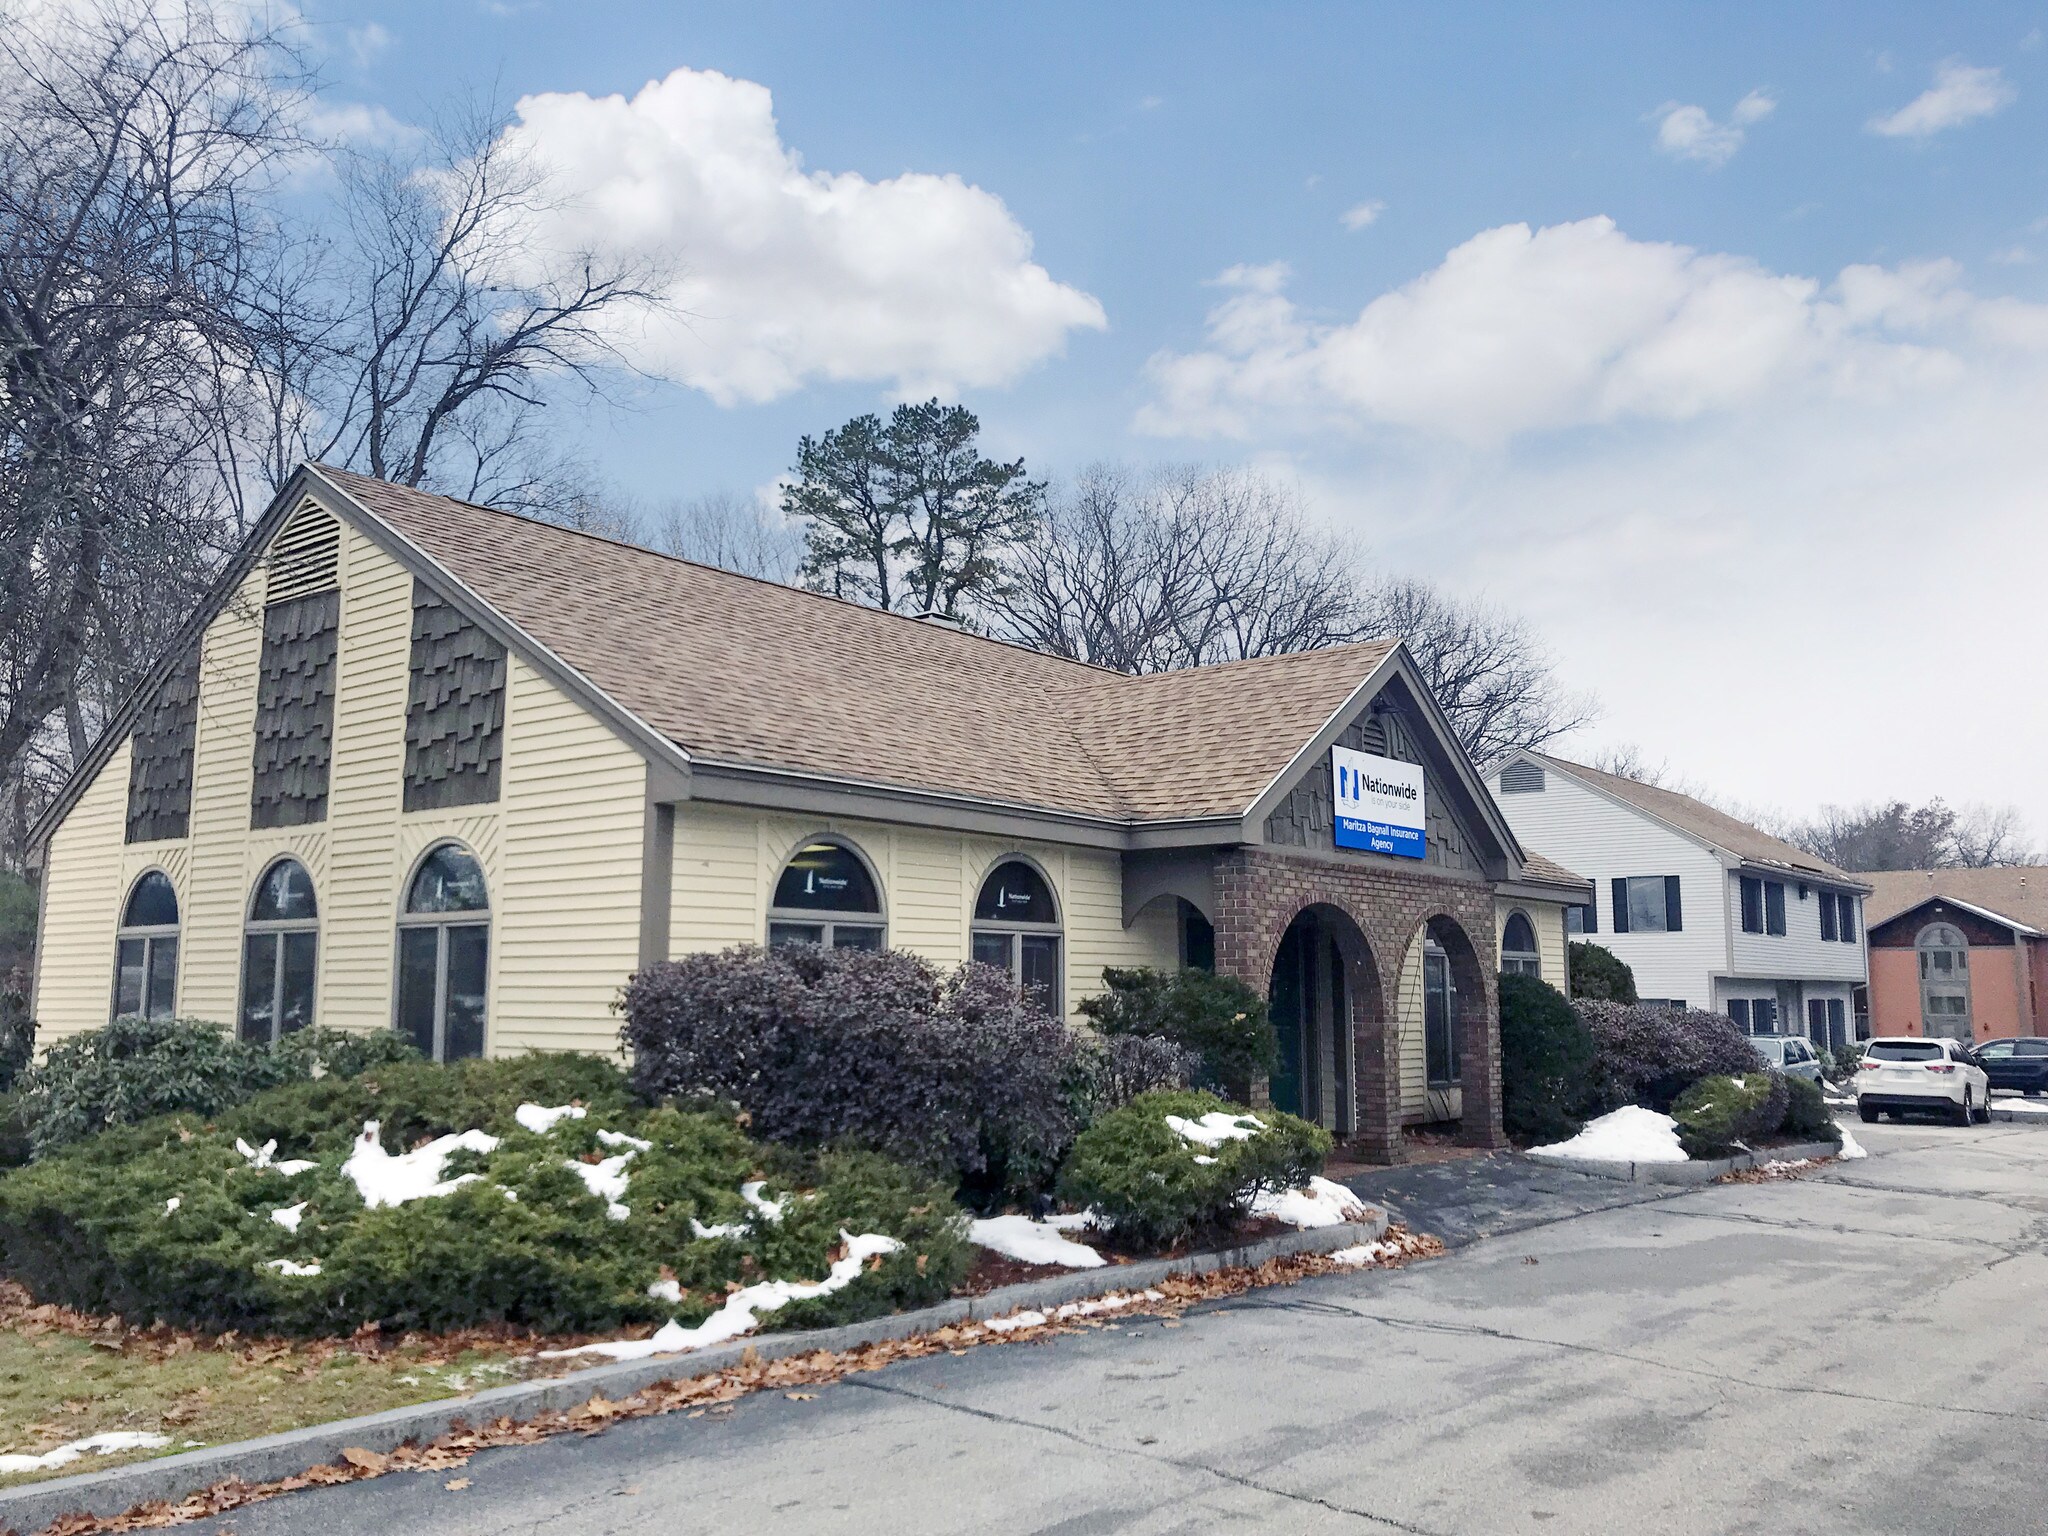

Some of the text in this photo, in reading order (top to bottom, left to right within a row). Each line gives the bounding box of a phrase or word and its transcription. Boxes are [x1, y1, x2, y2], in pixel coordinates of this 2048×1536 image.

[1362, 774, 1417, 800] Nationwide
[1385, 800, 1398, 808] your
[1343, 819, 1419, 840] Maritza Bagnall Insurance
[1371, 837, 1393, 851] Agency
